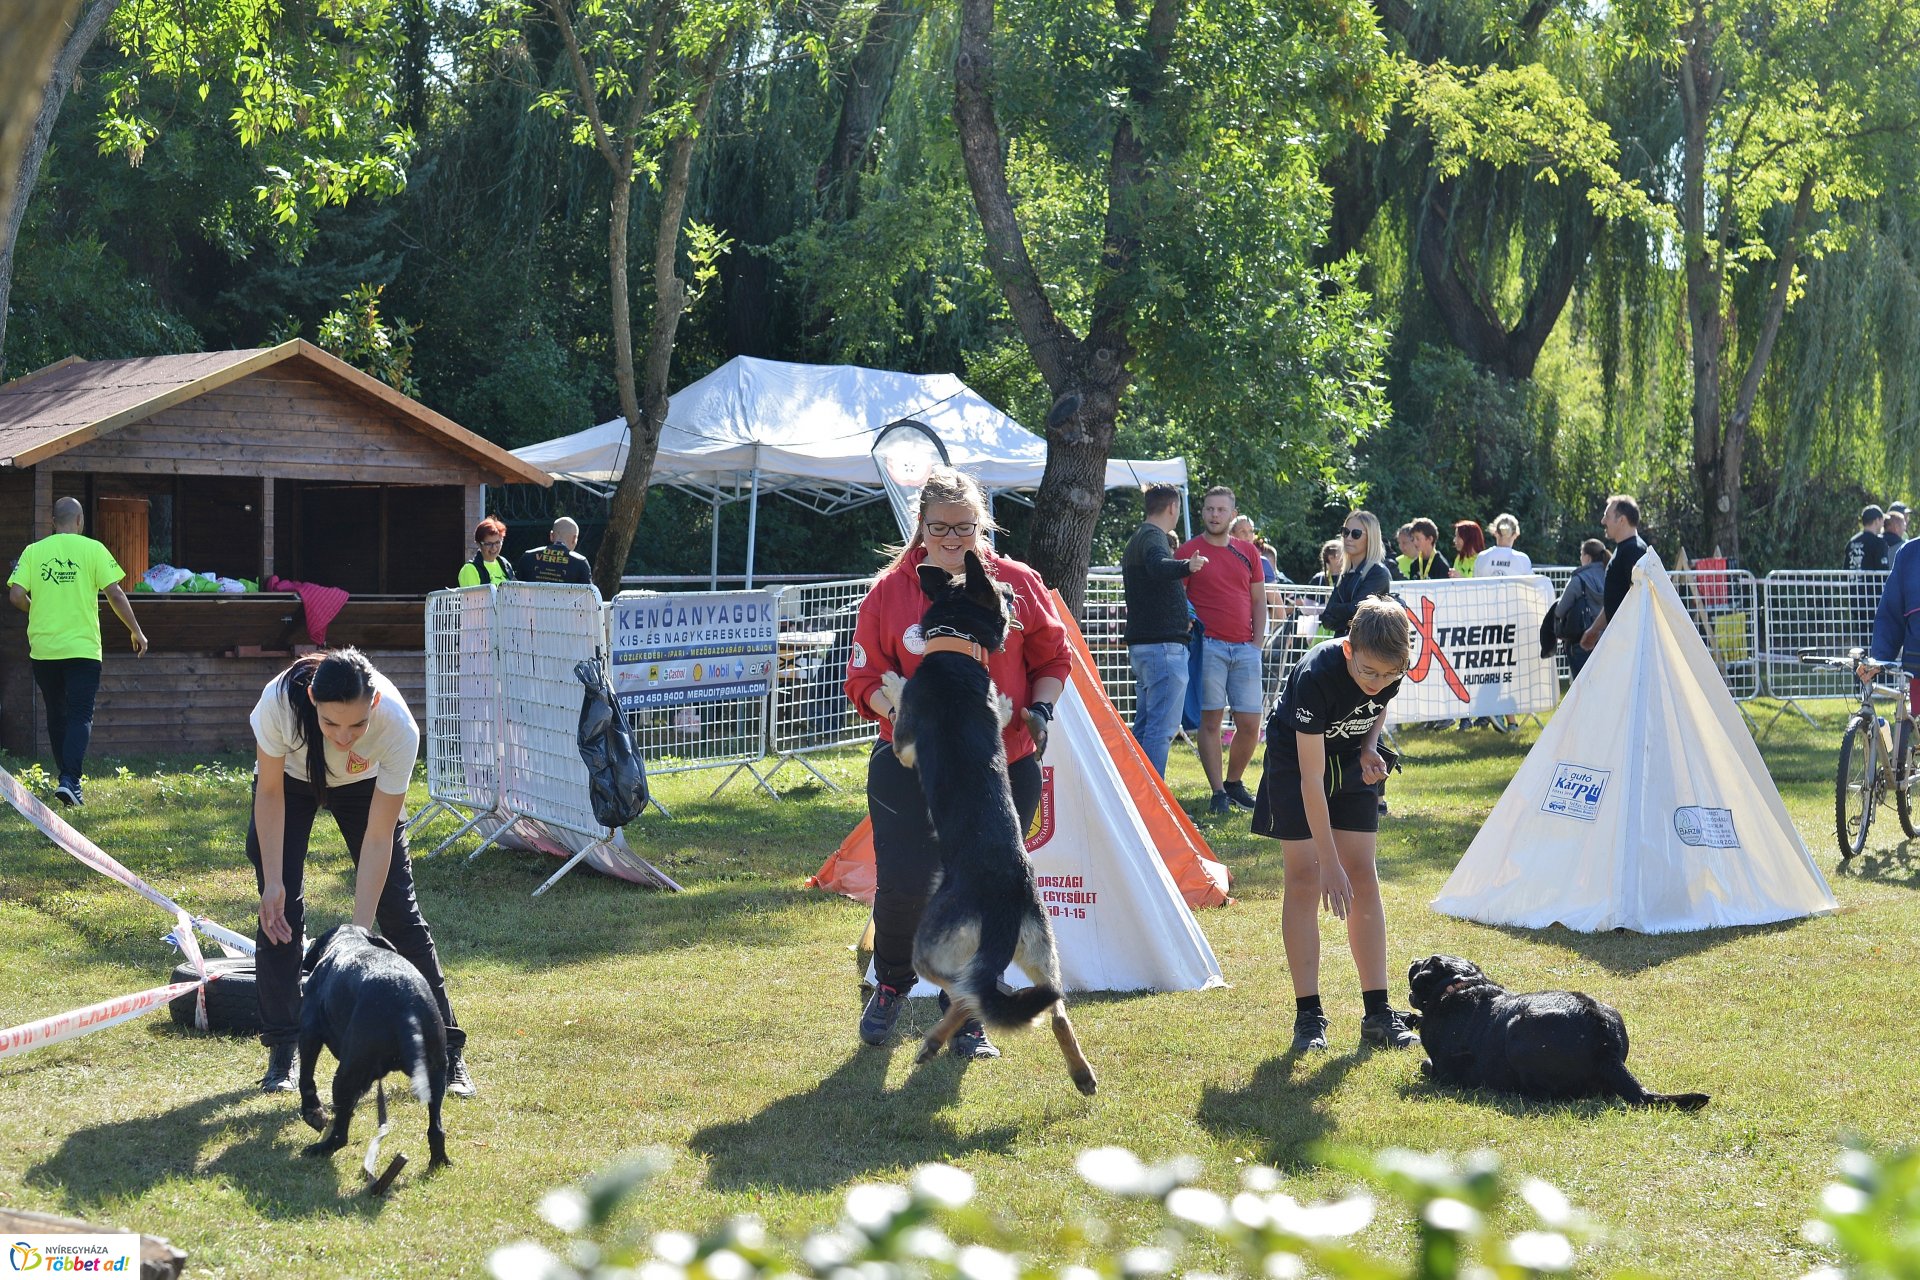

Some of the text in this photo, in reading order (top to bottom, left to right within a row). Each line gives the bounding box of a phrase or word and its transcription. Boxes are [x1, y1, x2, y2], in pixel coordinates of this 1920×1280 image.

[536, 553, 569, 564] VERES
[619, 601, 772, 630] KENŐANYAGOK
[664, 624, 772, 643] NAGYKERESKEDÉS
[747, 644, 772, 653] OLAJOK
[1452, 649, 1517, 669] TRAIL
[668, 668, 686, 680] Castrol
[708, 664, 730, 678] Mobil
[749, 663, 763, 674] elf
[1463, 672, 1512, 685] HUNGARY SE
[633, 695, 643, 703] 20
[646, 693, 662, 703] 450
[664, 691, 684, 701] 9400
[687, 683, 766, 699] MERUDIT@GMAIL.COM
[1570, 772, 1593, 782] autó
[1555, 777, 1600, 799] Kárpit
[1036, 875, 1083, 888] ORSZÁGI
[1043, 890, 1097, 904] EGYESÜLET
[1047, 905, 1086, 919] 50-1-15
